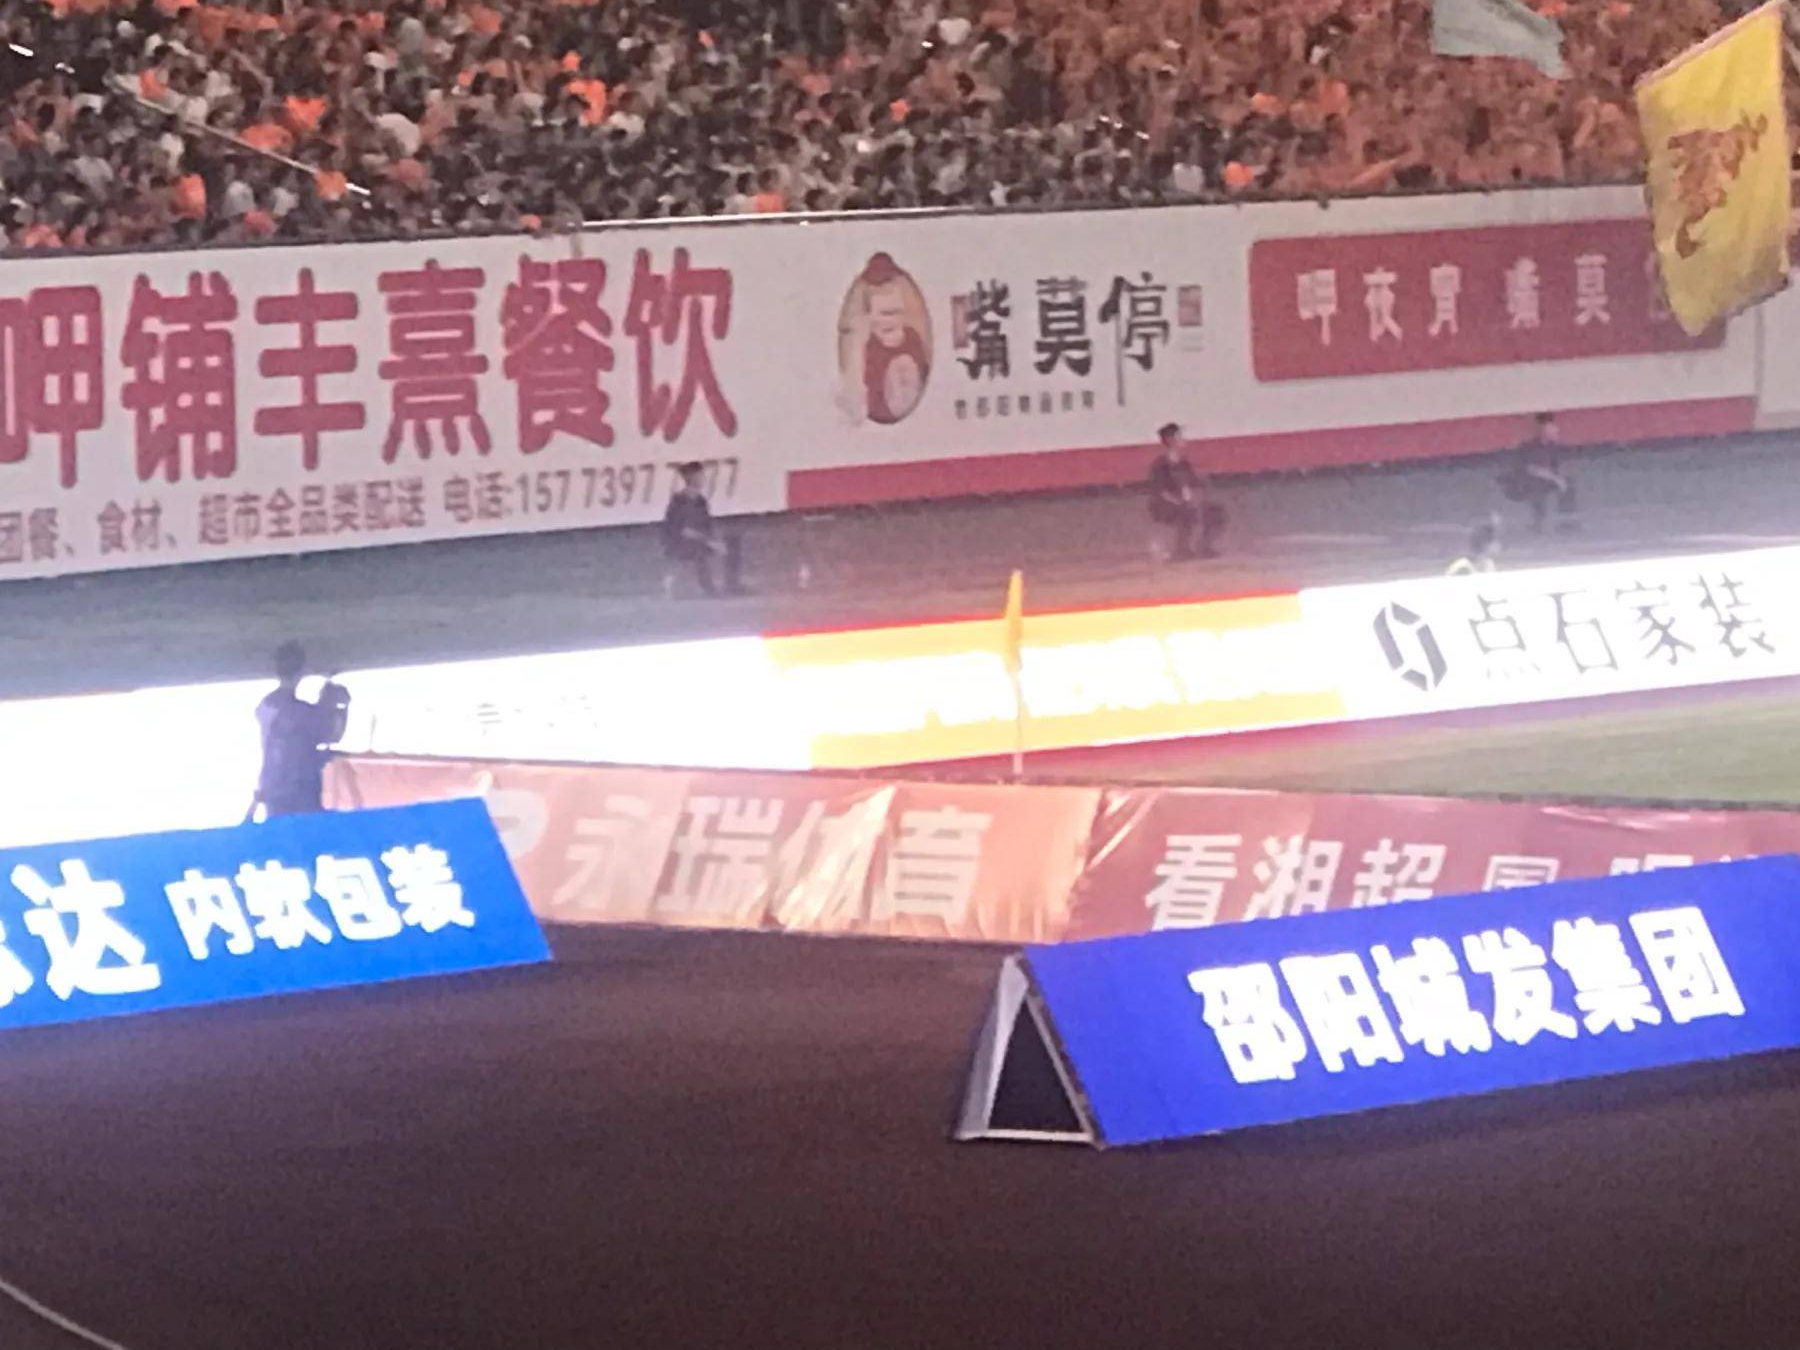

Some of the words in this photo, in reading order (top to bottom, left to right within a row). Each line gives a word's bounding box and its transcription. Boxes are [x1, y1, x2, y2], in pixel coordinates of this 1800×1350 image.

[1465, 572, 1777, 680] 点石家装
[0, 859, 161, 1008] 达
[1188, 906, 1747, 1084] 邵阳城发集团
